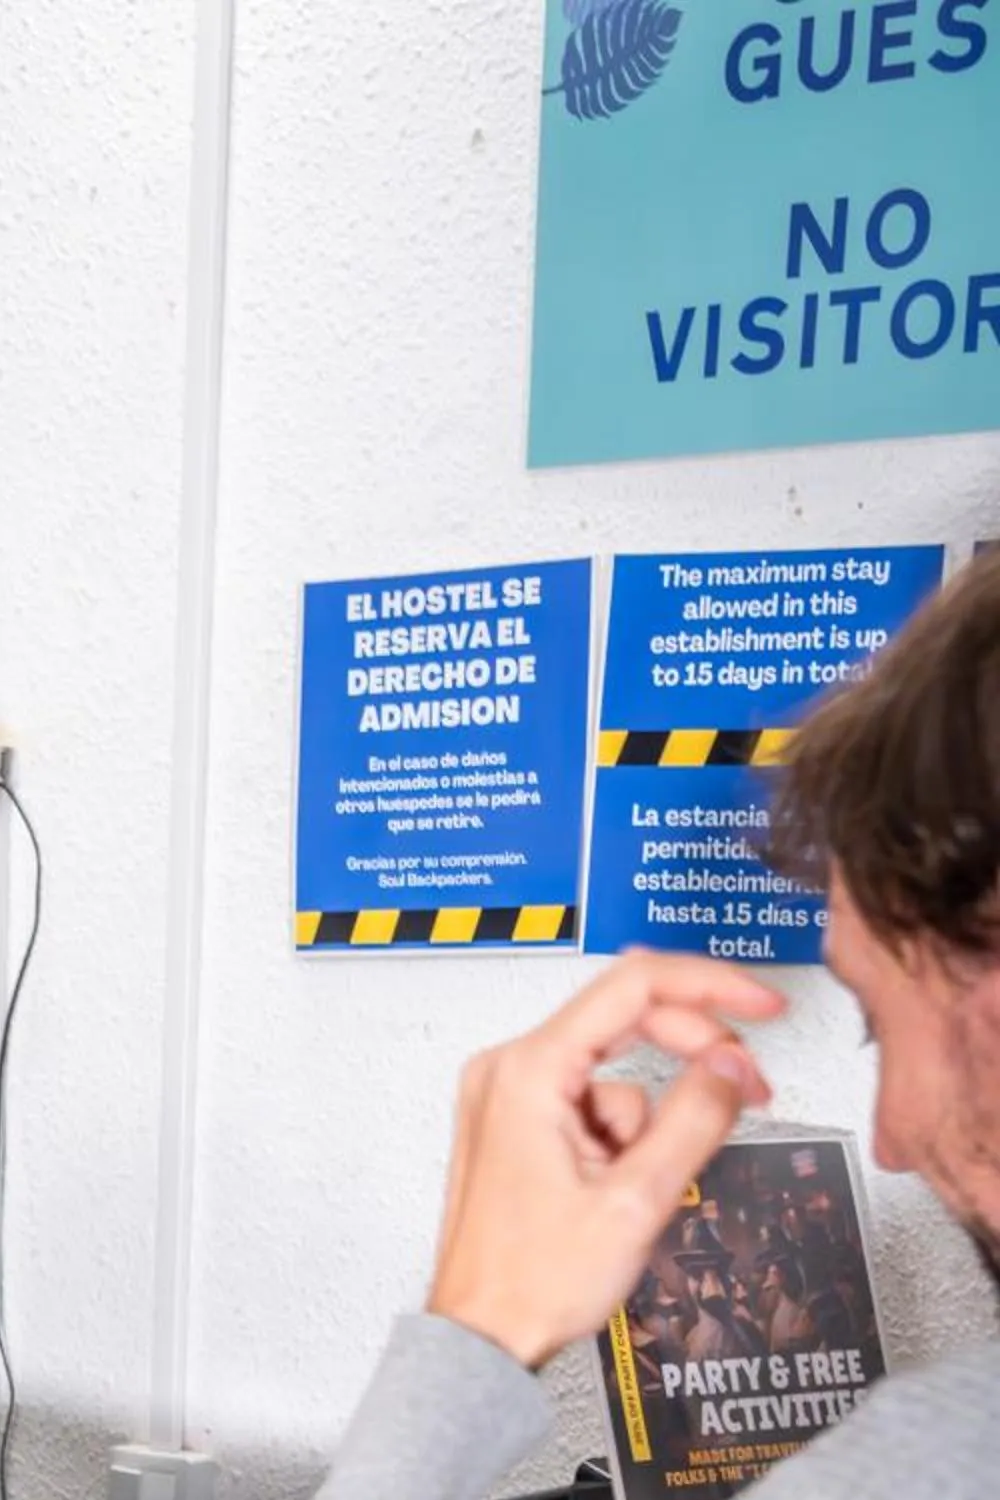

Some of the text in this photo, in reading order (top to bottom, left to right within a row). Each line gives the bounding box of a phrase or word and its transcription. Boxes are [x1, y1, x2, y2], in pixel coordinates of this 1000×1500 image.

[786, 188, 931, 278] NO
[659, 557, 891, 588] The maximum stay
[346, 577, 541, 622] EL HOSTEL SE
[682, 590, 858, 621] allowed in this
[354, 617, 531, 659] RESERVA EL
[650, 623, 888, 654] establishment is up
[347, 655, 537, 696] DERECHO DE
[652, 663, 679, 687] to
[683, 662, 714, 686] 15
[717, 660, 777, 691] days
[782, 659, 804, 683] in
[359, 695, 521, 732] ADMISION
[368, 756, 387, 772] En
[388, 754, 401, 771] el
[403, 755, 439, 771] caso
[441, 753, 460, 768] de
[441, 775, 450, 788] o
[453, 769, 525, 788] molestias
[527, 771, 539, 784] a
[335, 799, 375, 814] otros
[456, 795, 474, 808] se
[475, 791, 489, 807] le
[631, 803, 660, 827] La
[665, 804, 770, 828] estancia
[387, 813, 485, 835] que se retire.
[346, 855, 396, 871] Gracias
[398, 856, 422, 871] por
[424, 855, 439, 867] su
[378, 872, 405, 888] Soul
[648, 899, 716, 924] hasta
[722, 902, 752, 925] 15
[814, 909, 830, 927] e
[708, 935, 776, 959] total.
[661, 1349, 866, 1399] PARTY & FREE
[688, 1448, 728, 1466] MADE
[729, 1445, 754, 1462] FOR
[664, 1467, 708, 1487] FOLKS
[719, 1464, 744, 1480] THE
